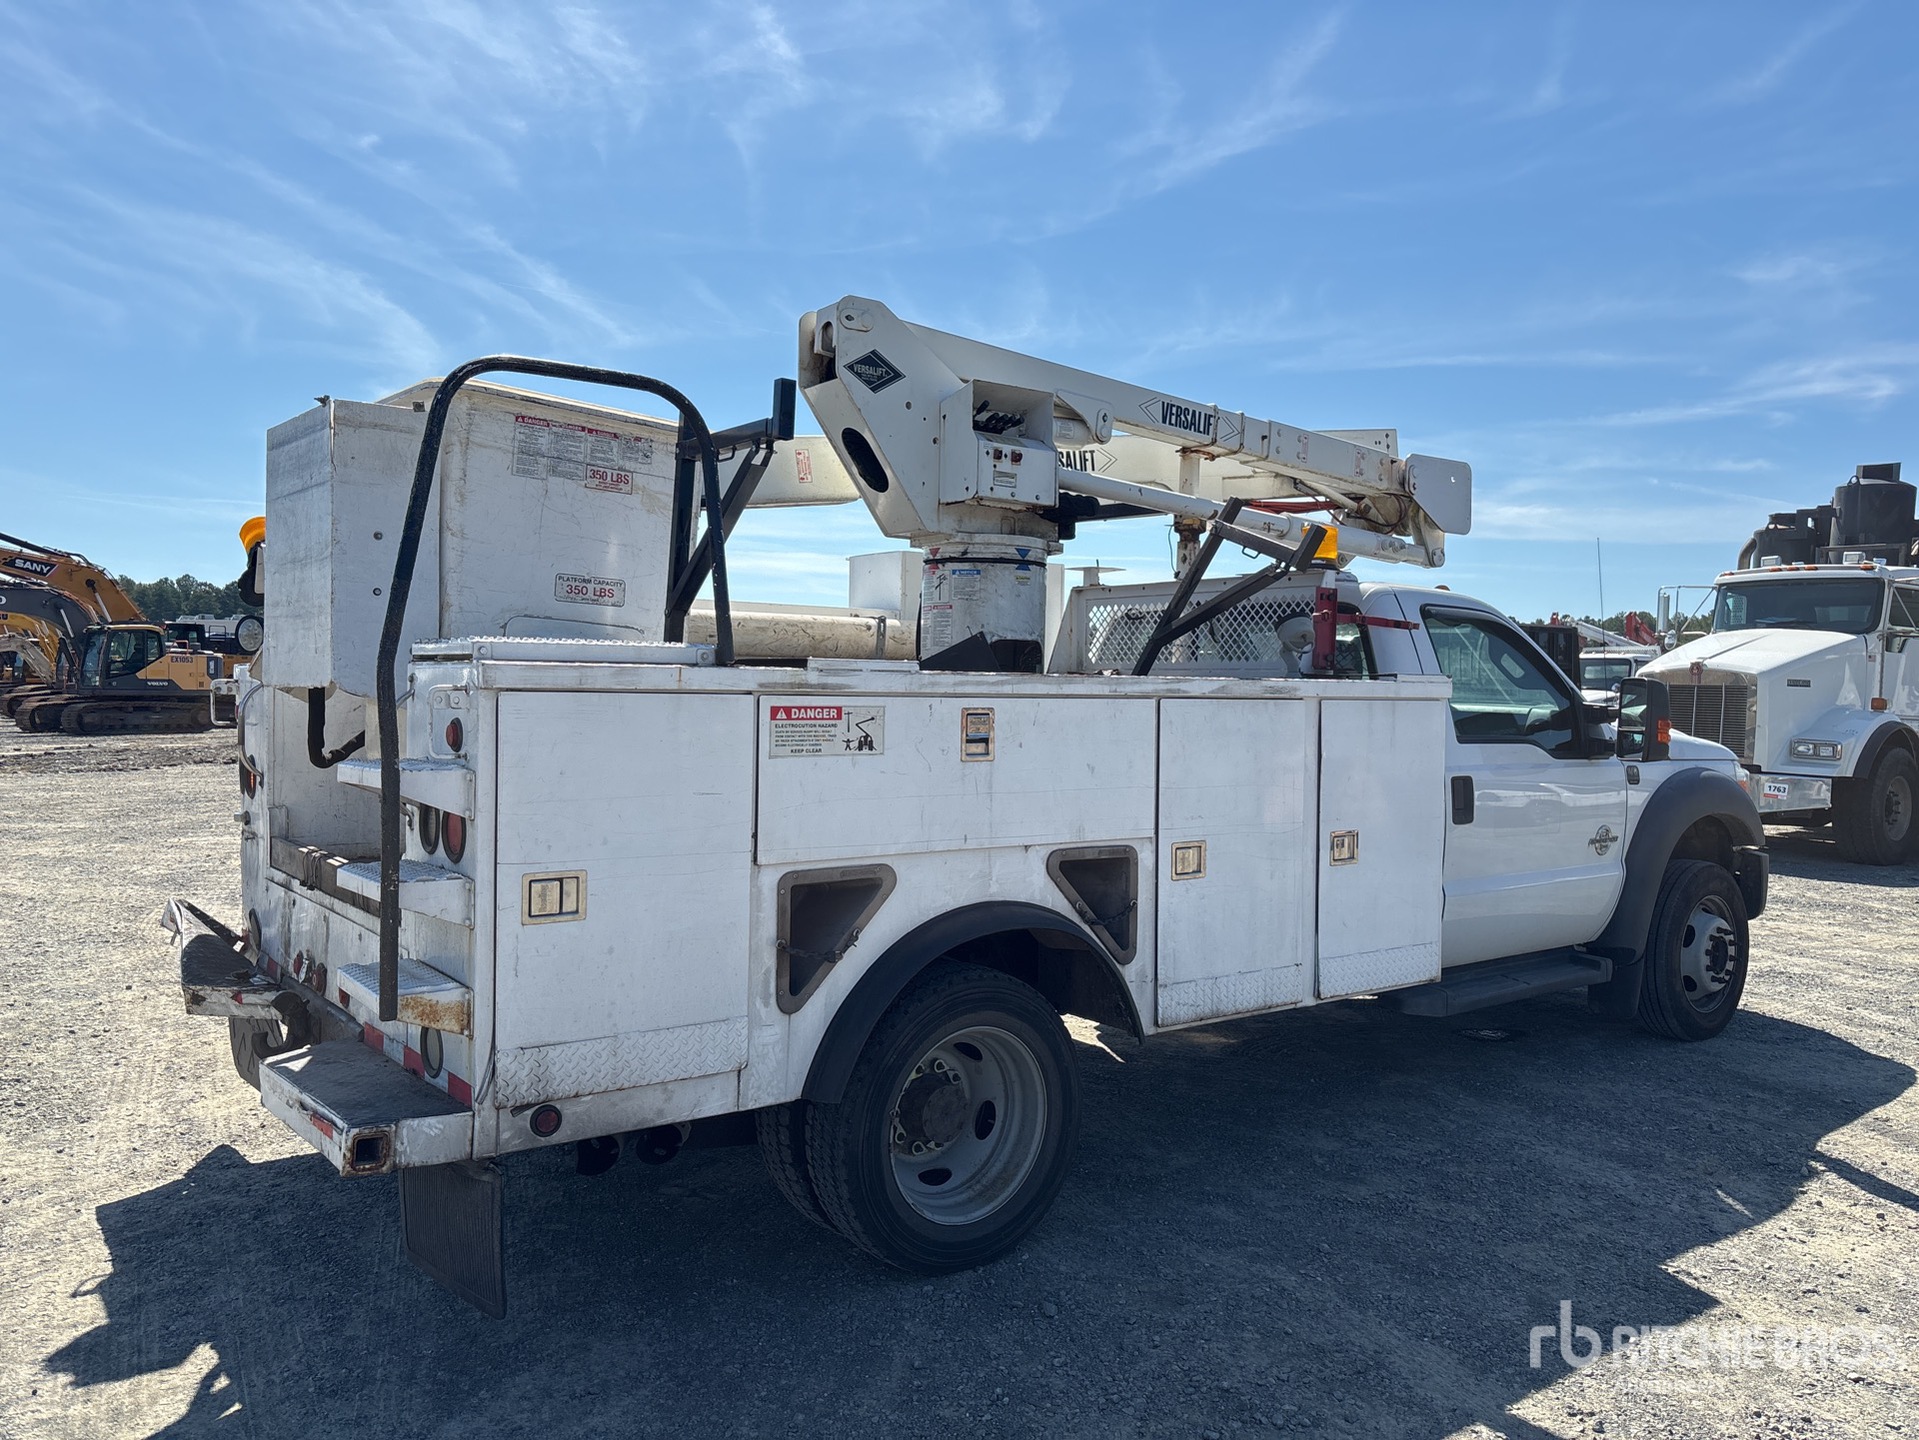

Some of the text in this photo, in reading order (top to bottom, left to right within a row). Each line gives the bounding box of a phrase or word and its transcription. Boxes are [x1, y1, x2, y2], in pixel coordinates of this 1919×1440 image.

[524, 416, 548, 427] DANGER
[590, 469, 629, 485] 350 LBS
[15, 559, 50, 573] SANY
[558, 576, 624, 587] PLATFORM CAPACITY
[566, 584, 615, 598] 350 LBS
[791, 708, 838, 719] DANGER
[1768, 785, 1786, 793] 1763
